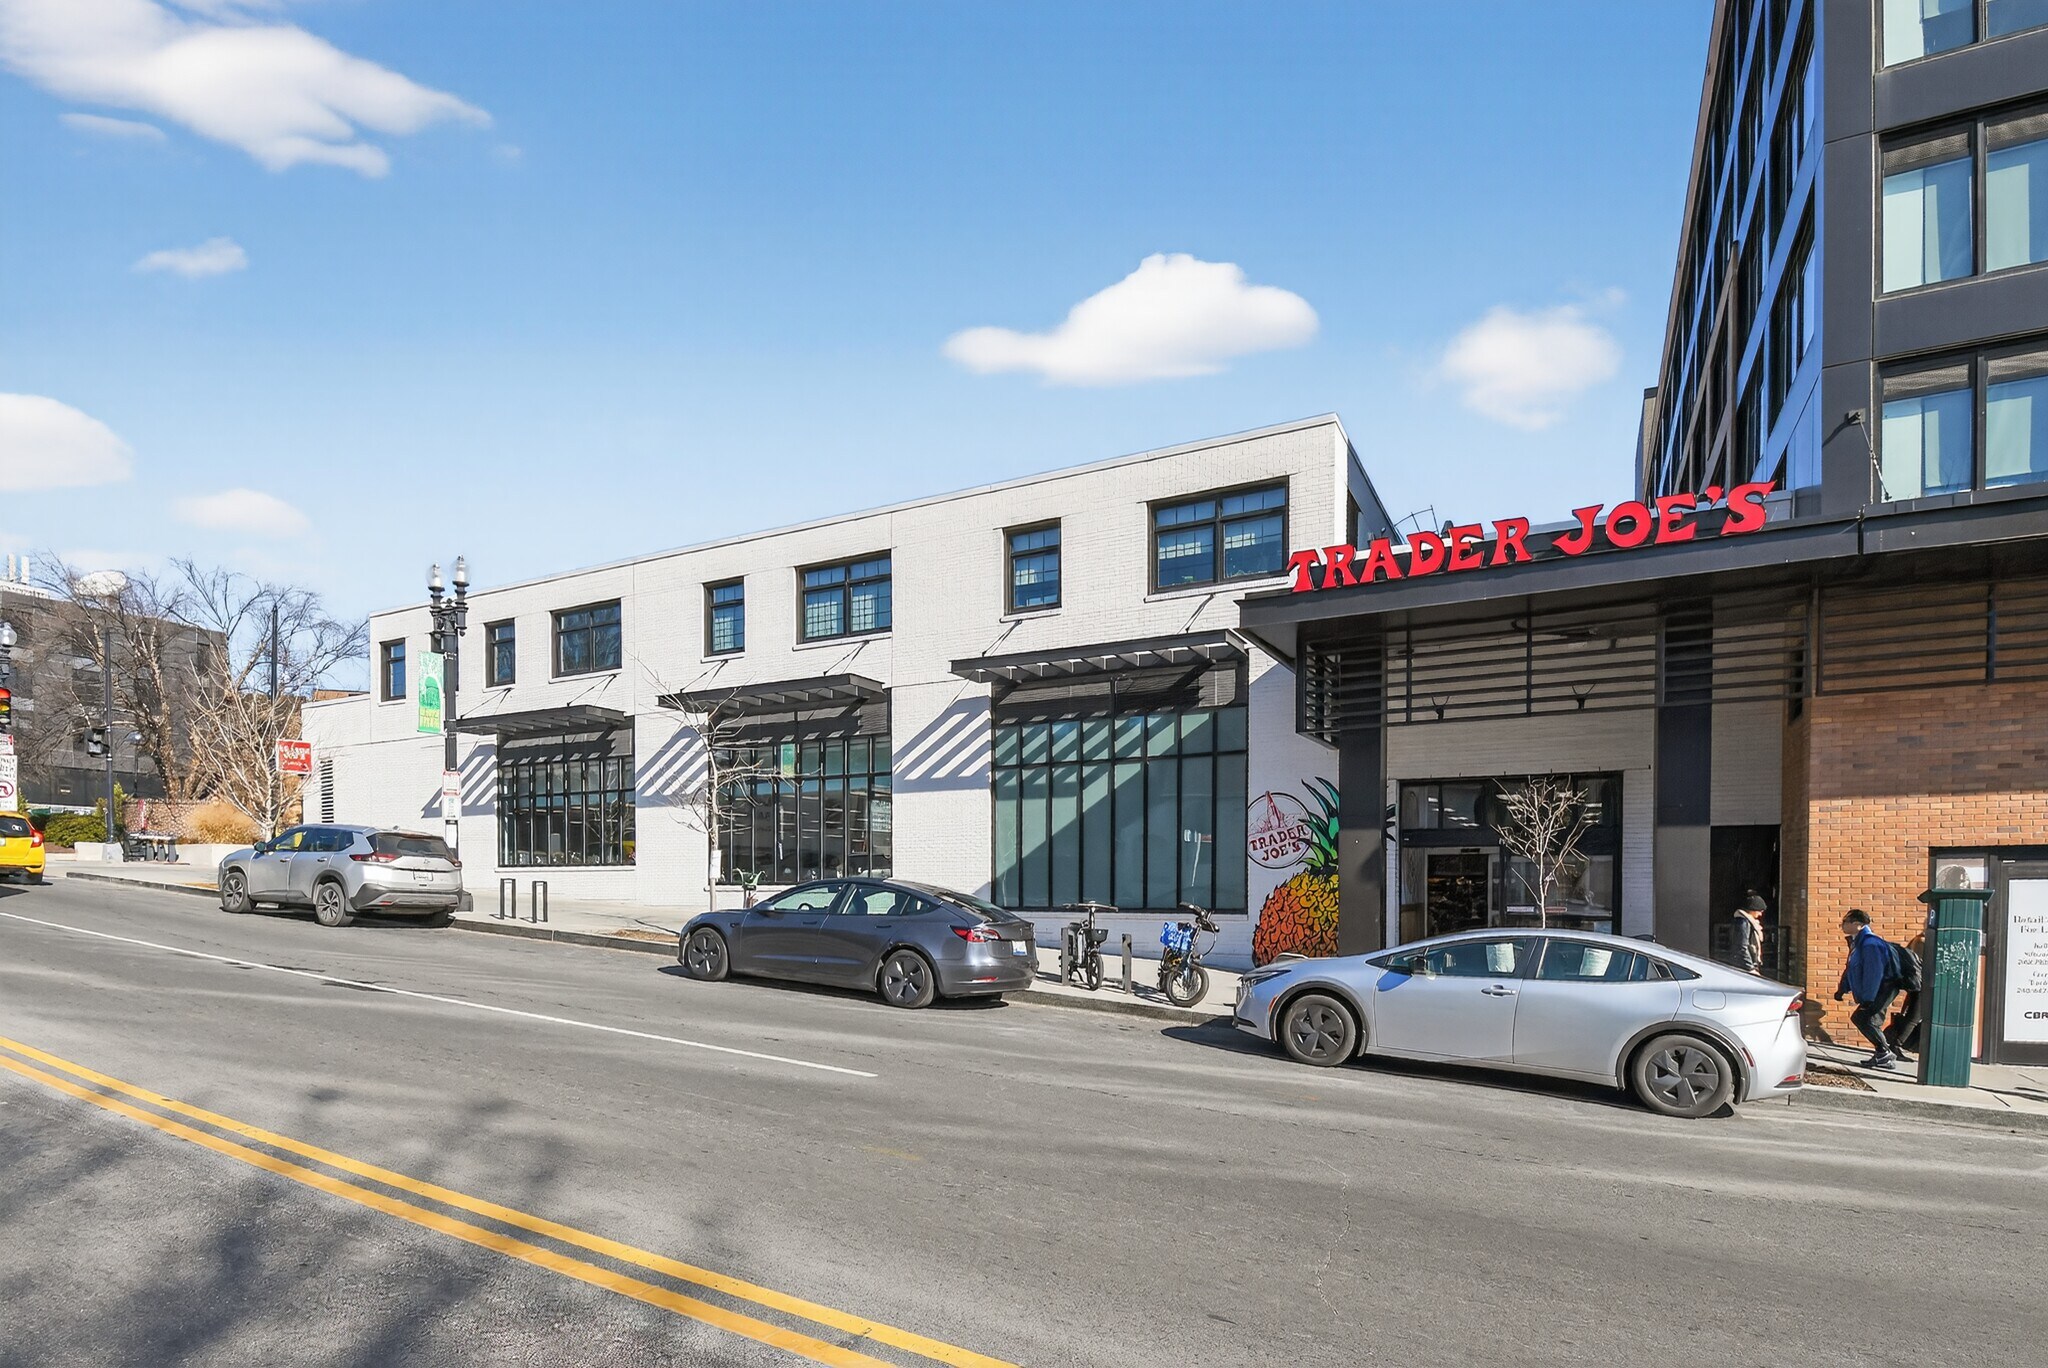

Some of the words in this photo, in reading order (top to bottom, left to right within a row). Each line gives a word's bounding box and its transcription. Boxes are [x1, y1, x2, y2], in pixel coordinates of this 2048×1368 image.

[1287, 517, 1533, 593] TRADER
[1552, 480, 1777, 555] JOE'S
[1249, 824, 1309, 851] TRADER
[1262, 841, 1302, 861] JOE'S
